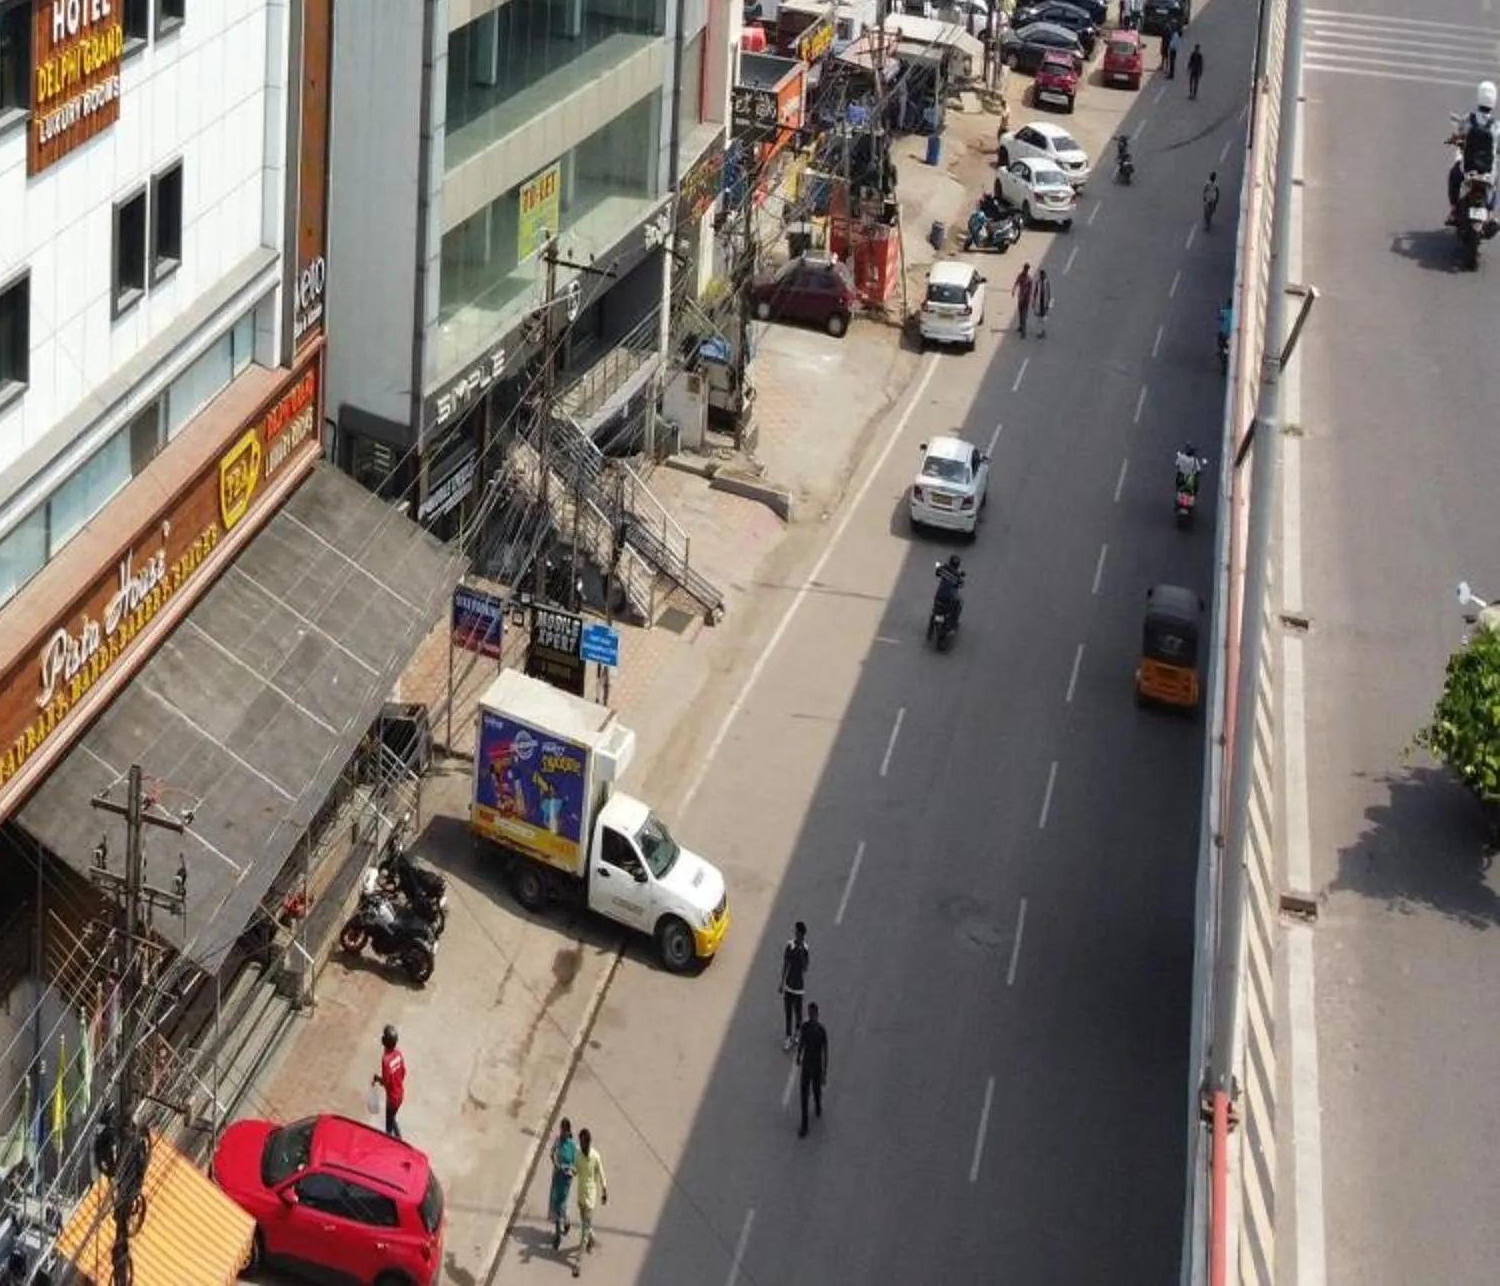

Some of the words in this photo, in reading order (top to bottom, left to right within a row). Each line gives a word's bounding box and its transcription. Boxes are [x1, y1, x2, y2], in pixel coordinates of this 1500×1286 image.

[81, 25, 123, 75] GRAND
[36, 95, 82, 144] LUXURY
[83, 75, 120, 117] ROOMS
[35, 611, 100, 707] Pista
